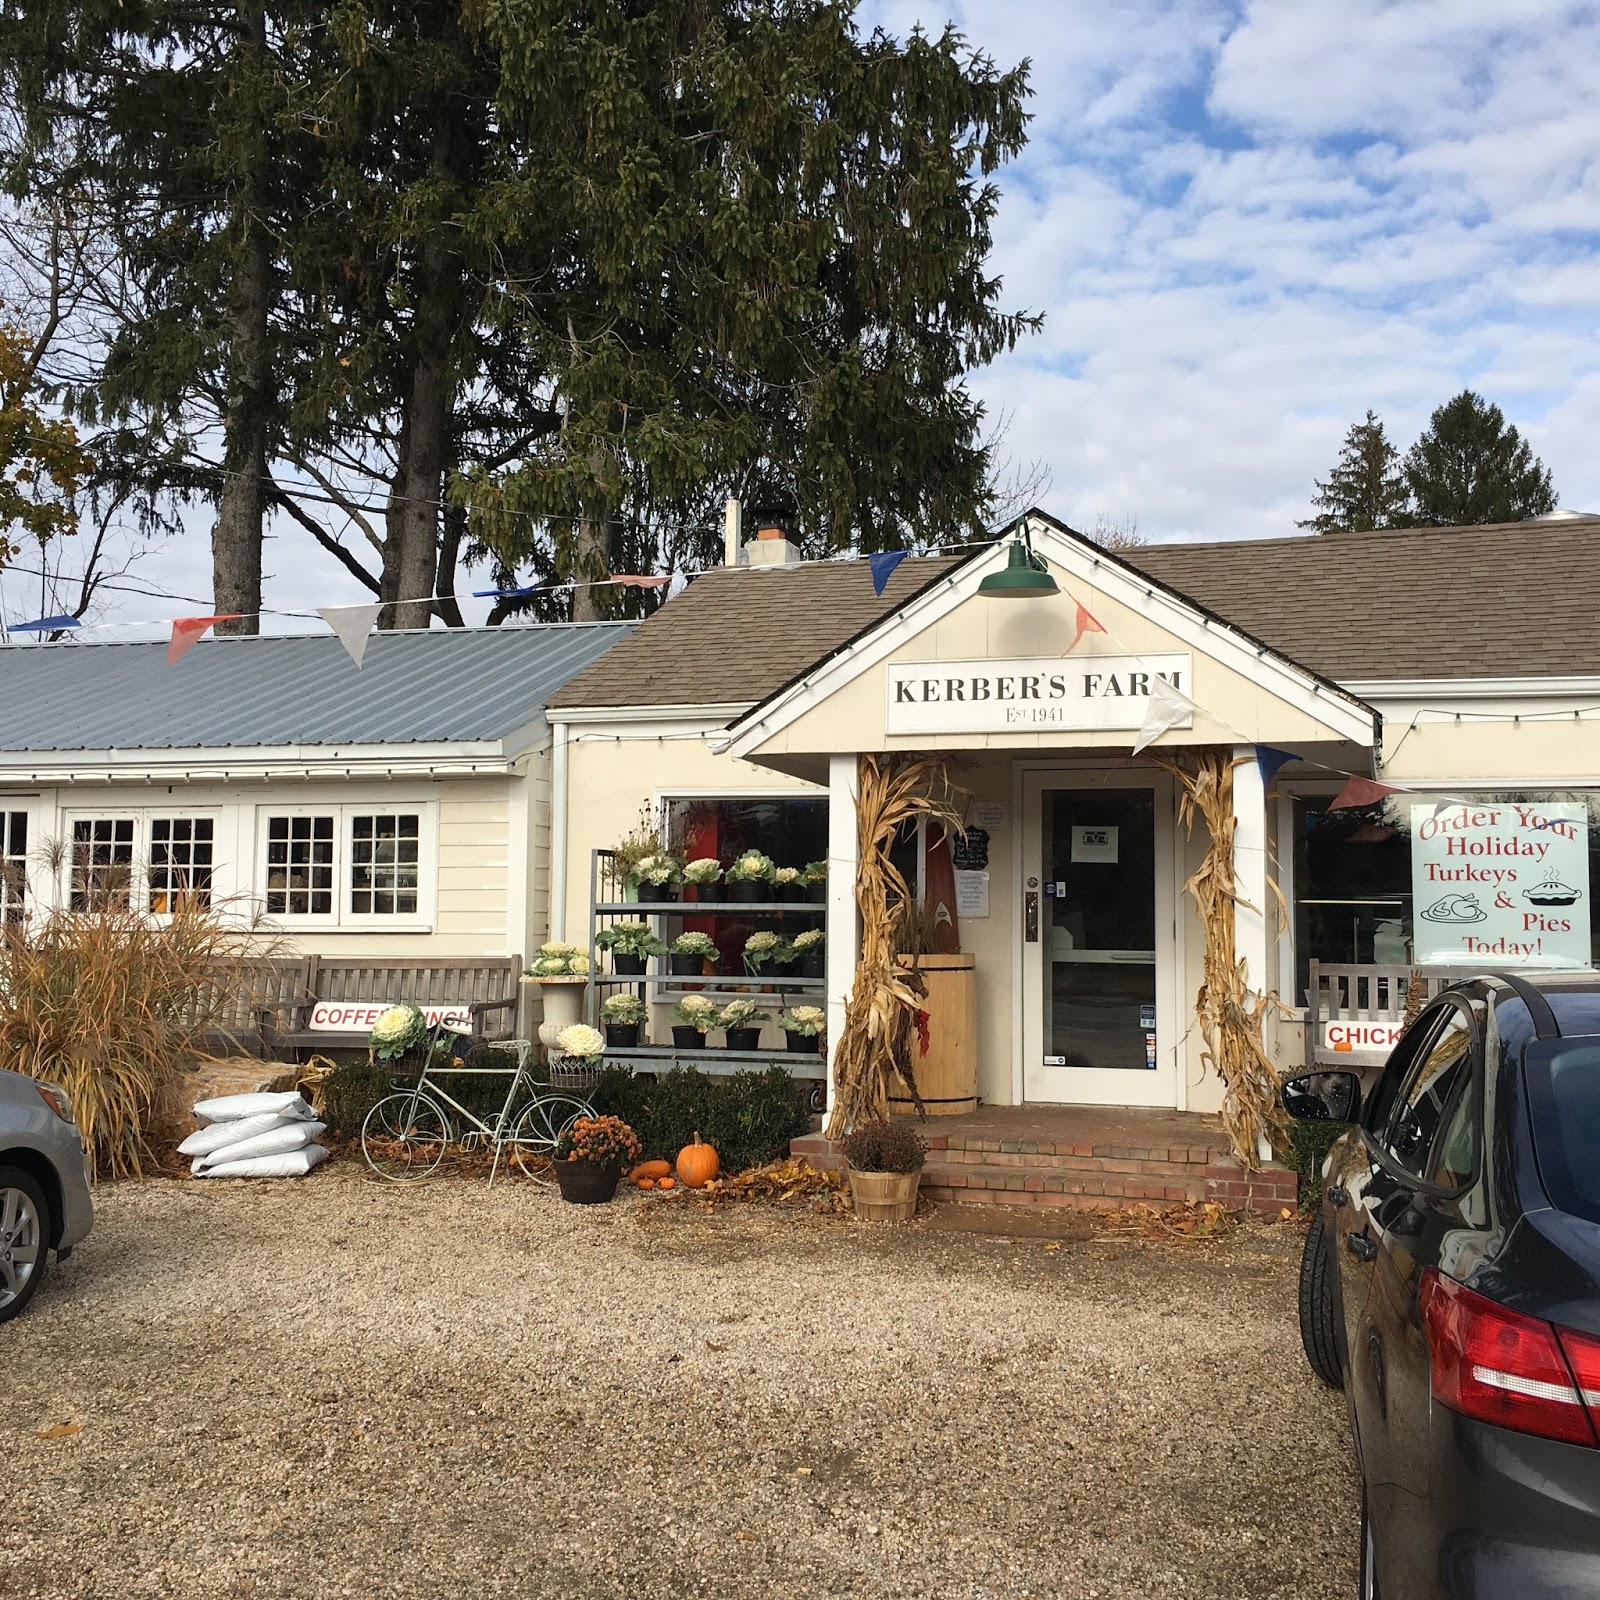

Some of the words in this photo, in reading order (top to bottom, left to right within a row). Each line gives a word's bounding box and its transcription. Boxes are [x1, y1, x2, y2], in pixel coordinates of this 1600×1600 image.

[894, 672, 1066, 703] KERBER'S
[1032, 707, 1064, 722] 1941
[1418, 807, 1501, 841] Order
[1512, 805, 1579, 842] Your
[1445, 836, 1550, 863] Holiday
[1423, 863, 1517, 888] Turkeys
[1493, 890, 1517, 909] &
[1522, 912, 1572, 932] Pies
[1461, 936, 1543, 962] Today!
[314, 1008, 386, 1025] COFFE
